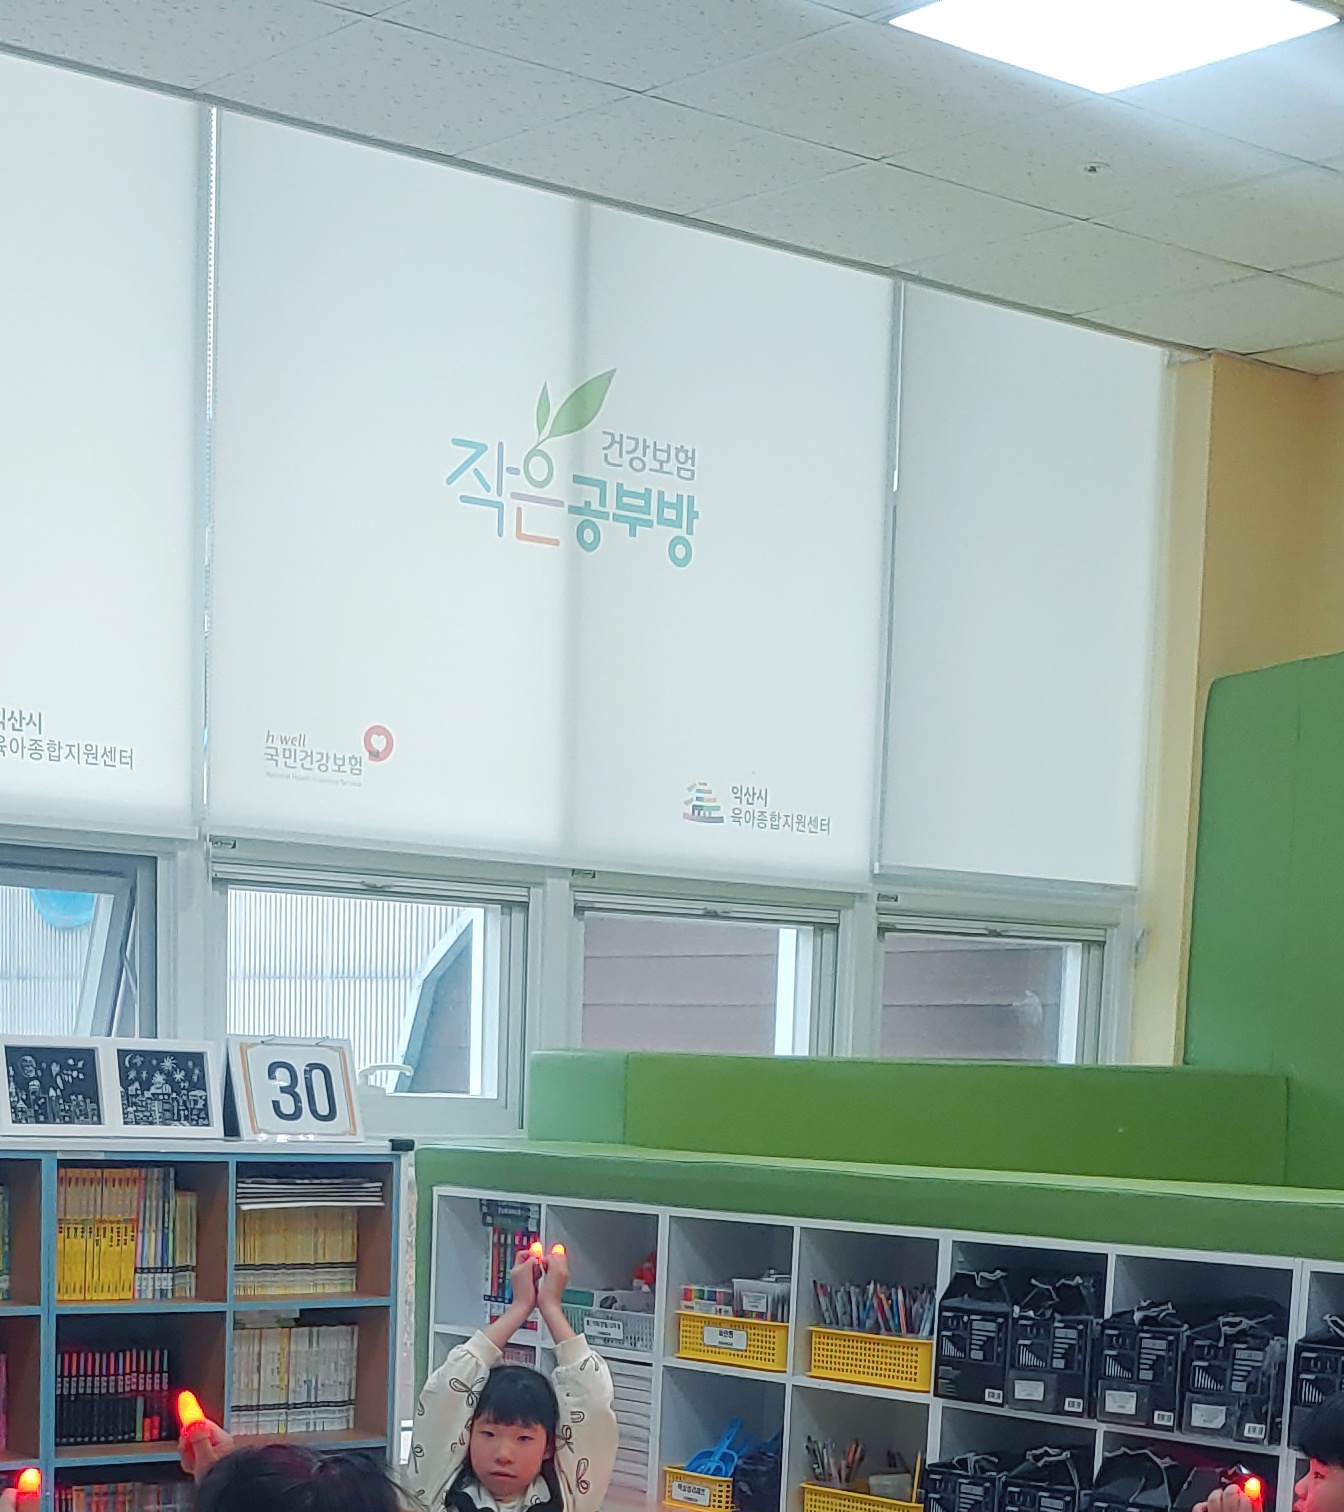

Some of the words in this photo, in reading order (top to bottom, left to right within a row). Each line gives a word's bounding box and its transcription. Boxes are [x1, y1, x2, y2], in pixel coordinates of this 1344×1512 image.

[601, 430, 697, 482] 건강보험
[445, 437, 566, 547] 작은
[568, 473, 700, 568] 공부방
[263, 746, 363, 776] 국민건강보험
[731, 784, 768, 808] 익산시
[730, 806, 831, 836] 육아종합지원센터
[267, 1060, 339, 1122] 30
